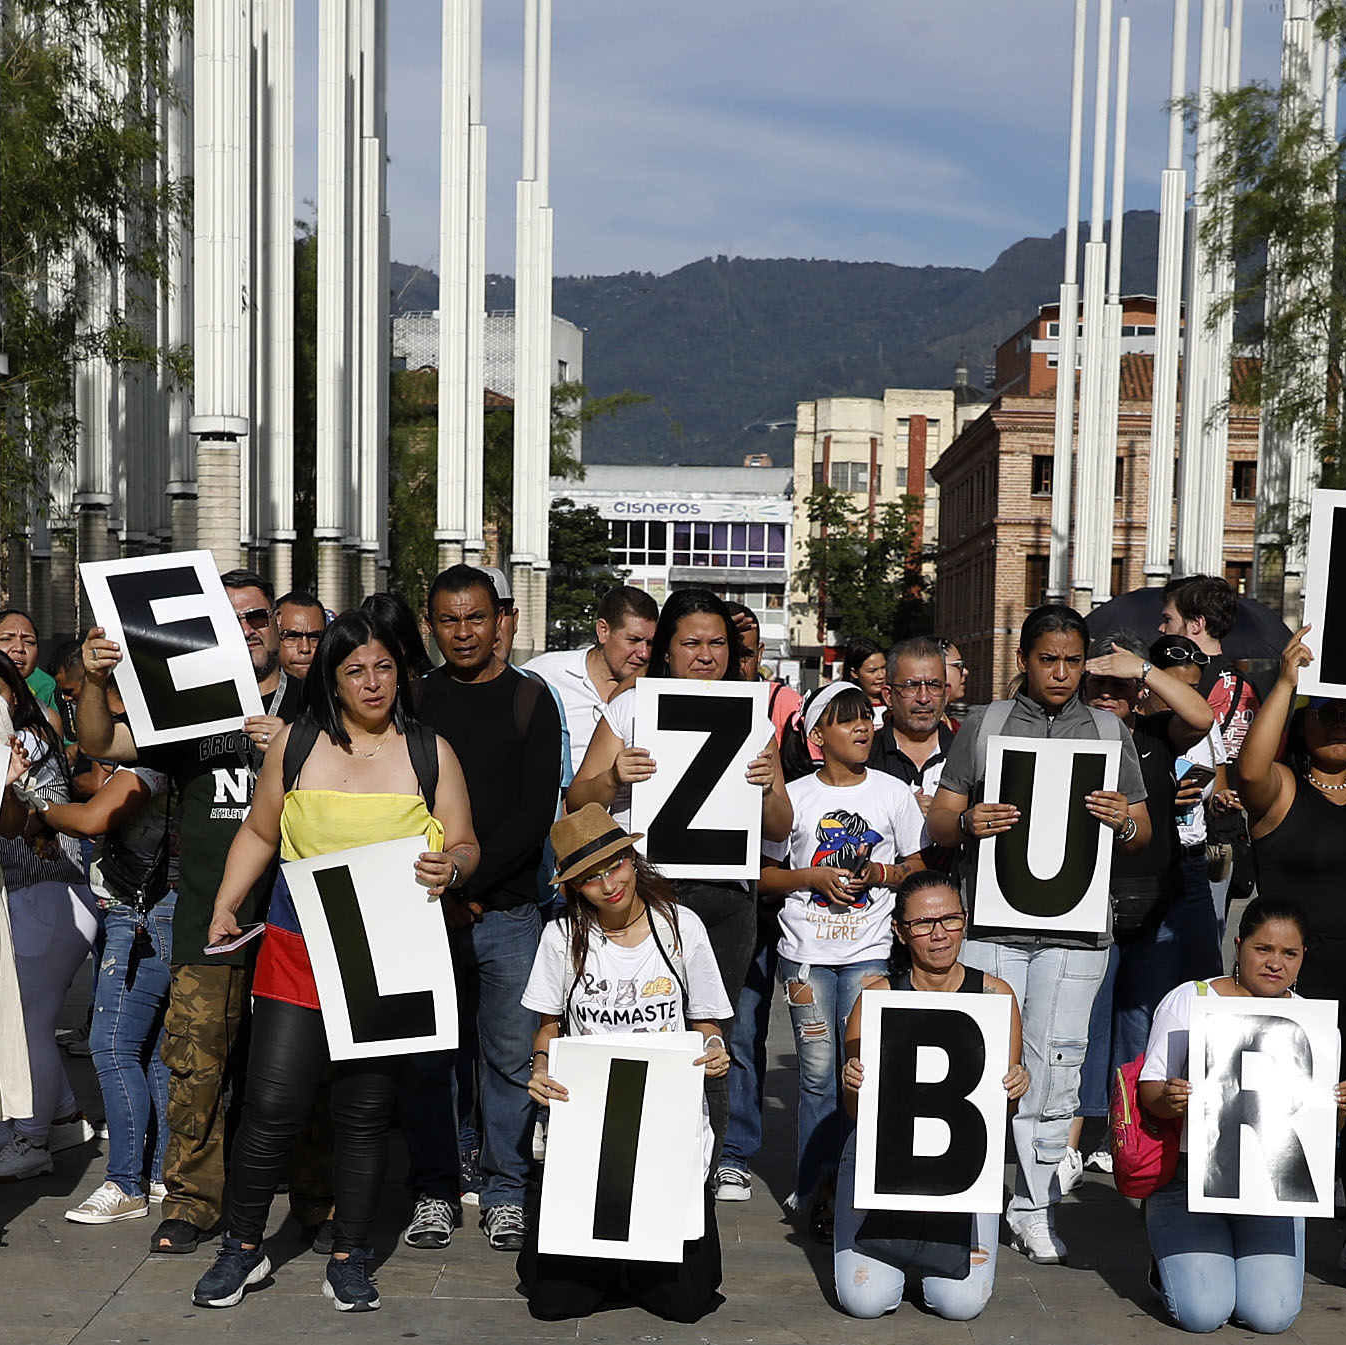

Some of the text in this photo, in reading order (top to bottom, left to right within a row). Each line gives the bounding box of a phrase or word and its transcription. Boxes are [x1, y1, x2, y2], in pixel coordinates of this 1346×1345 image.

[106, 566, 244, 731] E
[210, 808, 245, 820] ATHLET
[646, 694, 753, 865] Z
[995, 750, 1106, 917] U
[312, 865, 436, 1043] L
[576, 1000, 676, 1025] NYAMASTE
[816, 924, 859, 940] LIBRE
[593, 1058, 648, 1242] I
[874, 1007, 987, 1196] B
[1204, 1013, 1318, 1202] R
